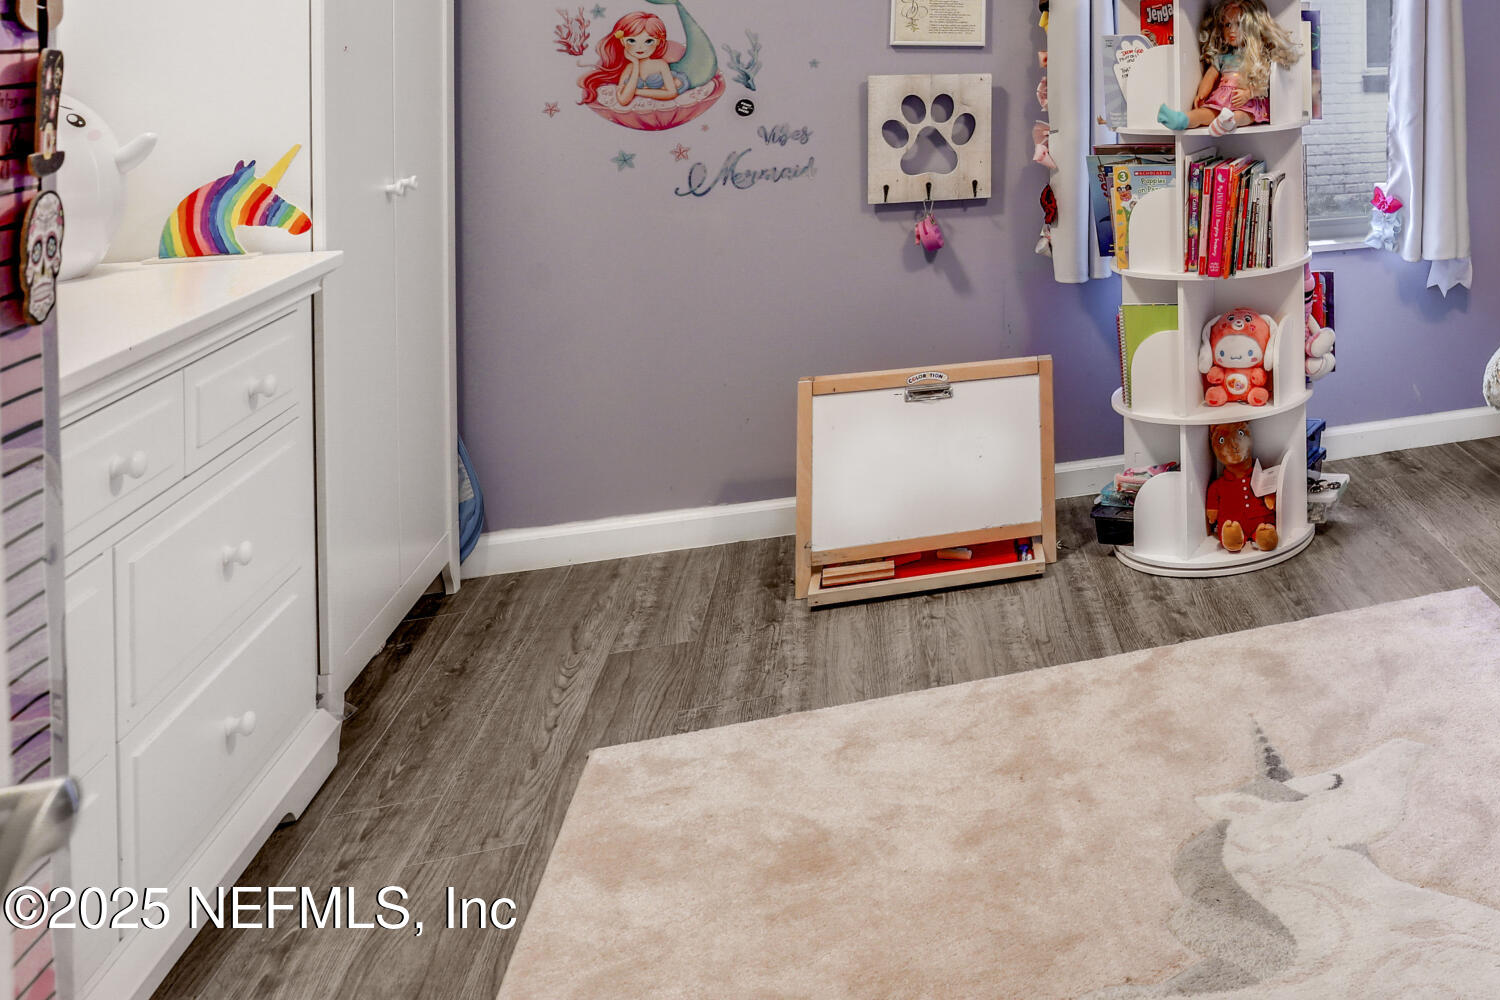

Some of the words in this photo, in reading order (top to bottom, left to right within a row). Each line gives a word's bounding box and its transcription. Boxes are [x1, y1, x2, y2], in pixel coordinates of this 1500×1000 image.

[1146, 3, 1174, 23] Jenga
[757, 123, 813, 146] Vibes
[674, 148, 818, 197] Mermaid
